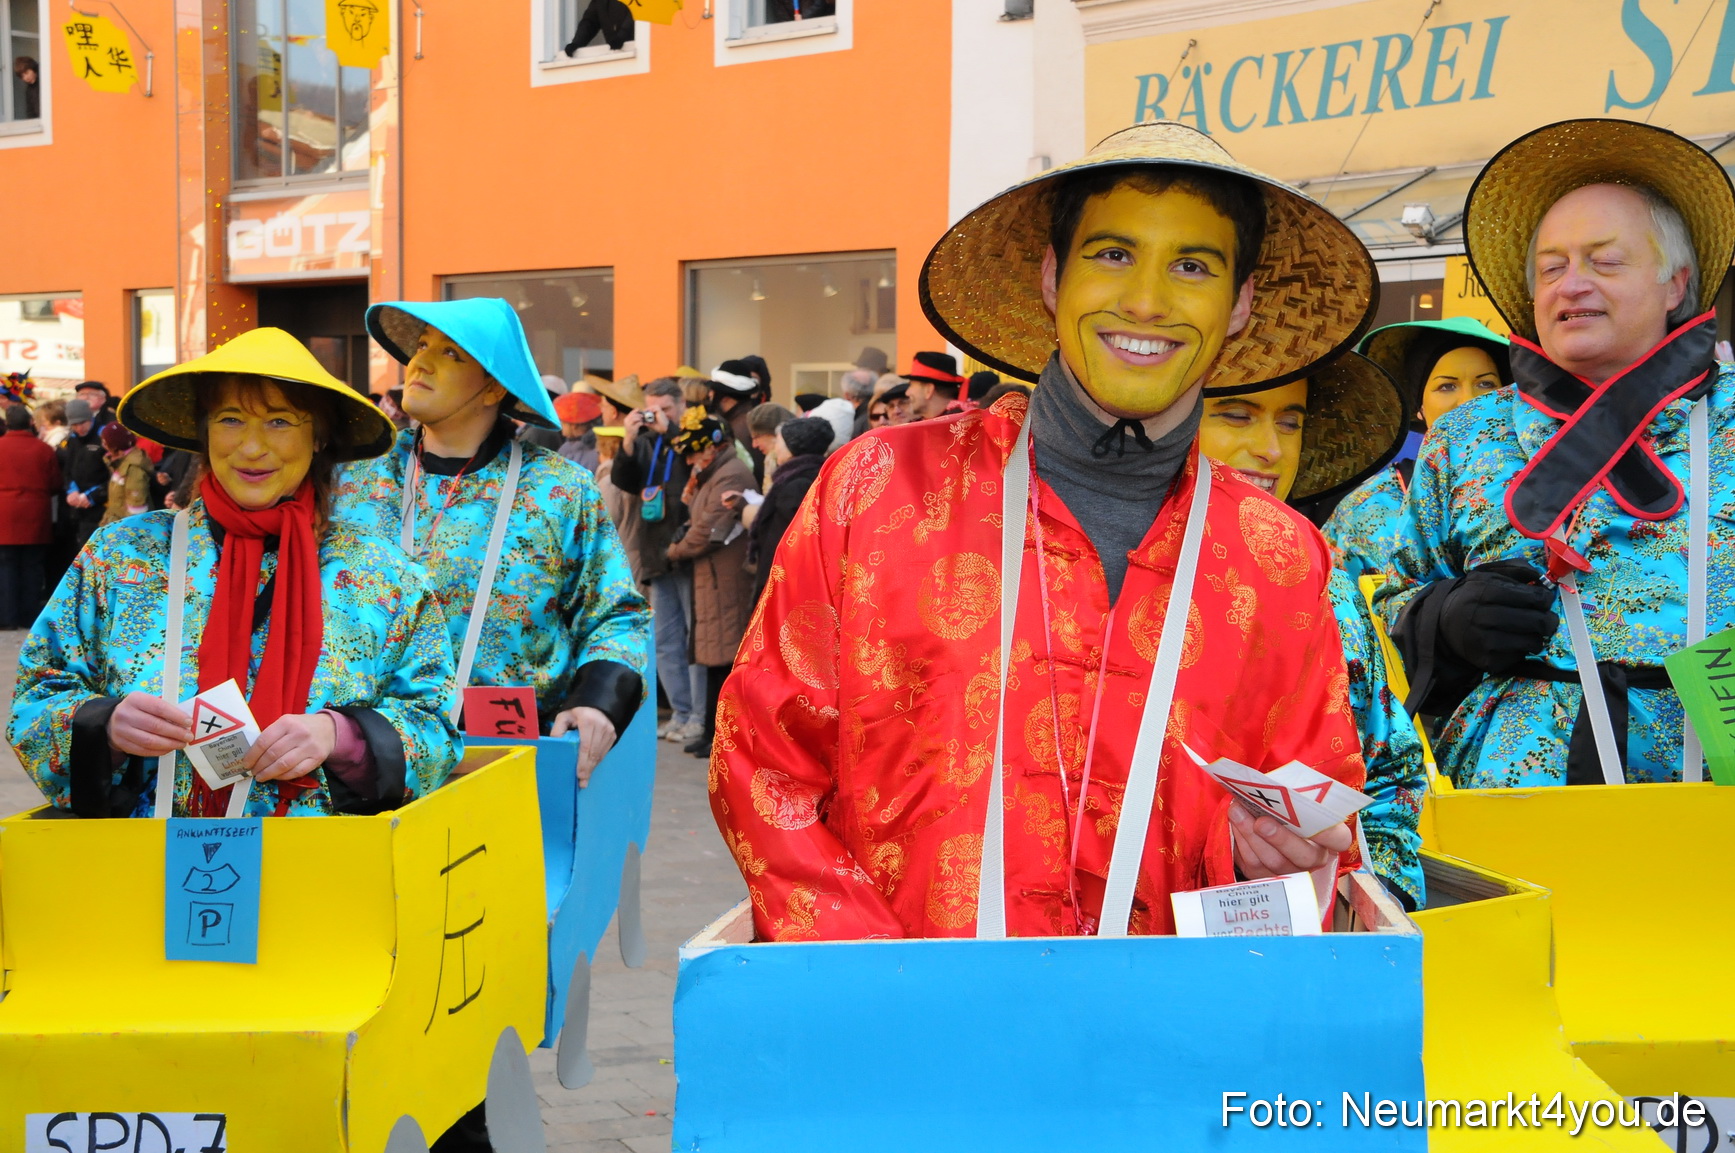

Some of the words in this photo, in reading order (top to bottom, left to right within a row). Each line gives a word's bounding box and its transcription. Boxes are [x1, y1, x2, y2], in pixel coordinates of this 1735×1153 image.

[1134, 15, 1511, 135] BÄCKEREI
[228, 210, 370, 259] GÖTZ
[489, 697, 526, 735] Fü
[217, 743, 235, 752] China
[222, 757, 244, 770] Link
[201, 873, 217, 891] 2
[1219, 898, 1242, 908] hier
[1250, 894, 1270, 907] gilt
[198, 908, 222, 938] P
[1223, 908, 1270, 924] Links
